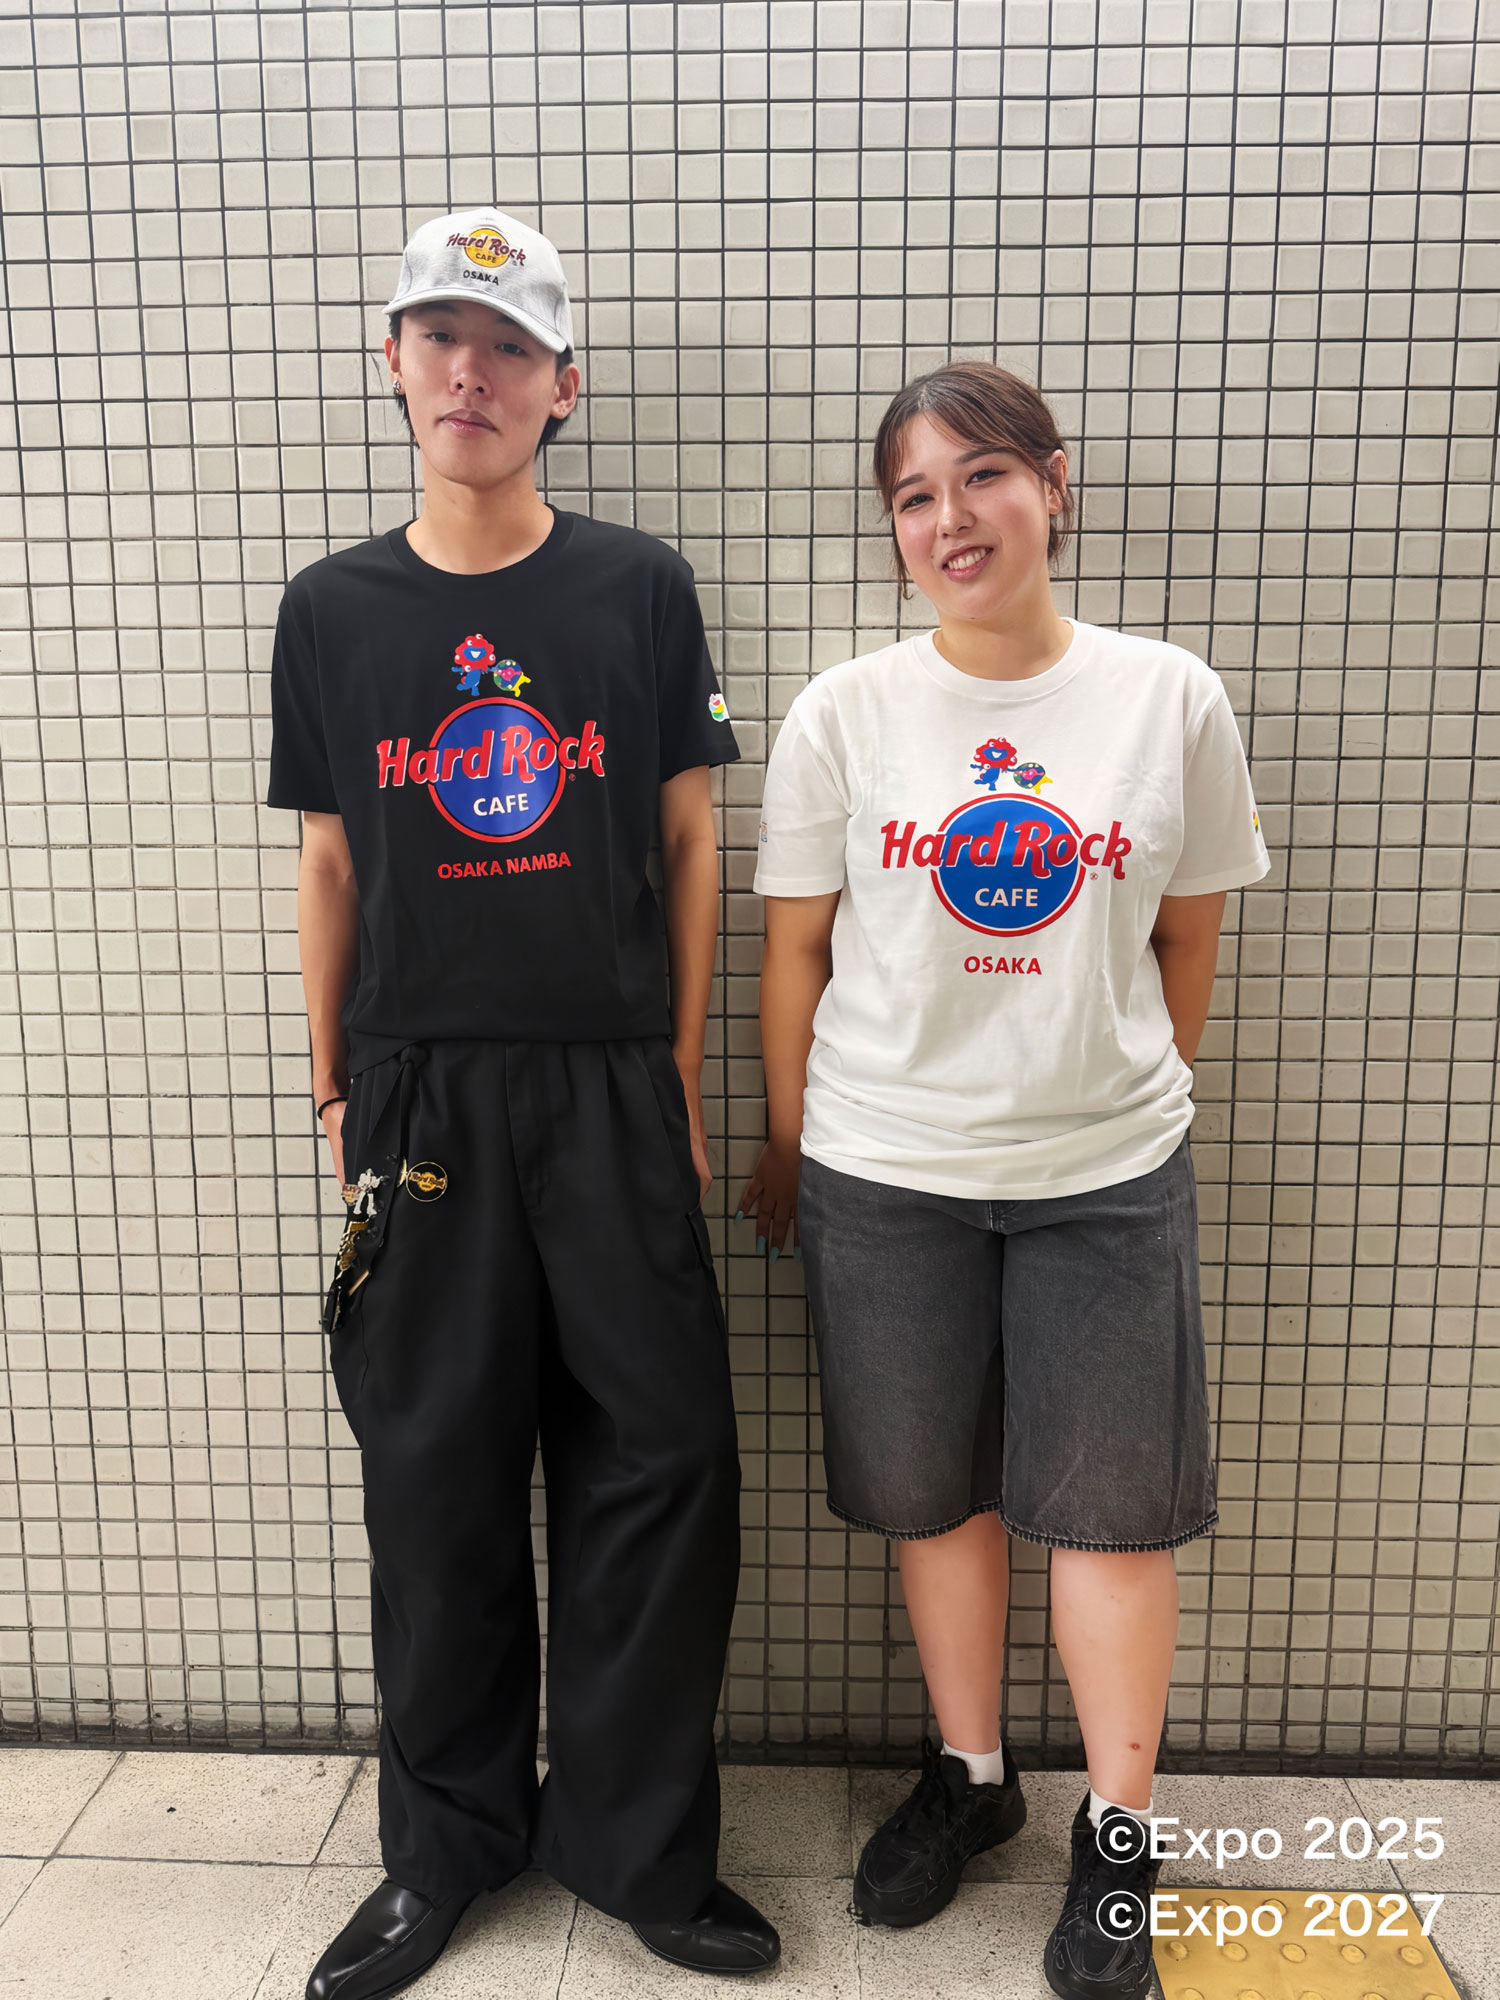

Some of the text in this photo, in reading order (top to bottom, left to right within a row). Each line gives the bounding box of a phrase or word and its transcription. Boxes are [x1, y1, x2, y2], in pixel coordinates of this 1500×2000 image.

[446, 233, 526, 266] Hard Rock
[475, 253, 497, 263] CAFE
[463, 270, 499, 286] OSAKA
[377, 720, 605, 788] Hard Rock
[473, 793, 529, 816] CAFE
[881, 820, 1132, 880] Hard Rock
[437, 852, 571, 879] OSAKA NAMBA
[975, 888, 1038, 907] CAFE
[964, 956, 1042, 975] OSAKA
